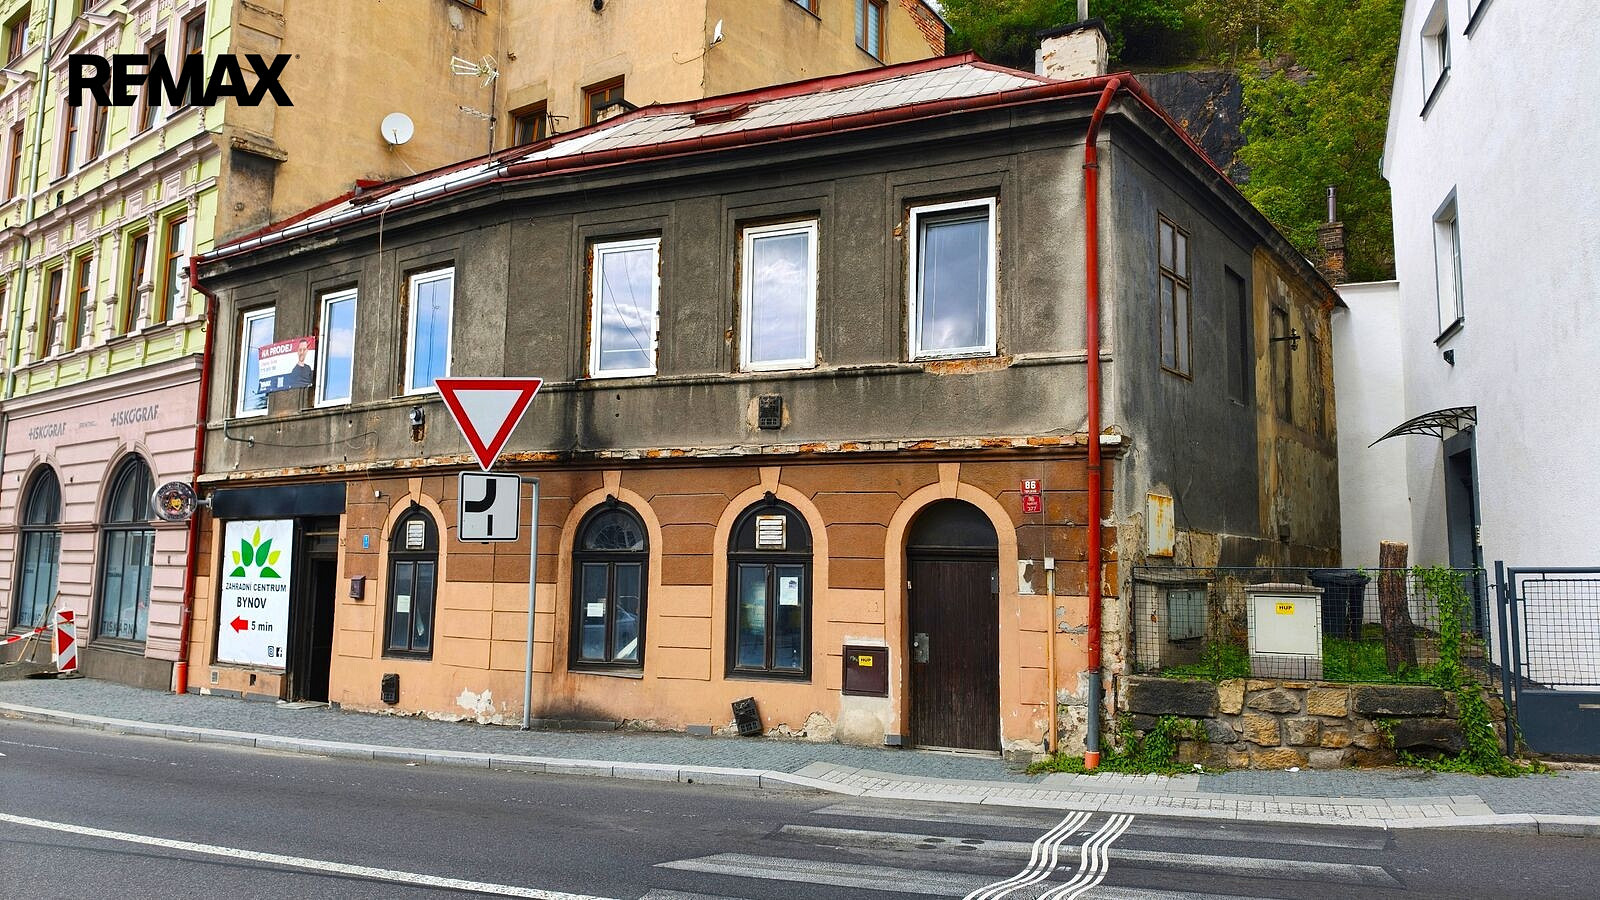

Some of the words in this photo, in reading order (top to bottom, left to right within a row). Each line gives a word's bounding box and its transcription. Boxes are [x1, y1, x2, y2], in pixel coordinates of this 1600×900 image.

[269, 343, 293, 356] PRODEJ
[1025, 481, 1037, 489] 86
[225, 581, 251, 592] ZAHRADNÍ
[253, 583, 287, 592] CENTRUM
[236, 596, 267, 609] BYNOV
[251, 621, 256, 631] 5
[258, 621, 273, 632] min
